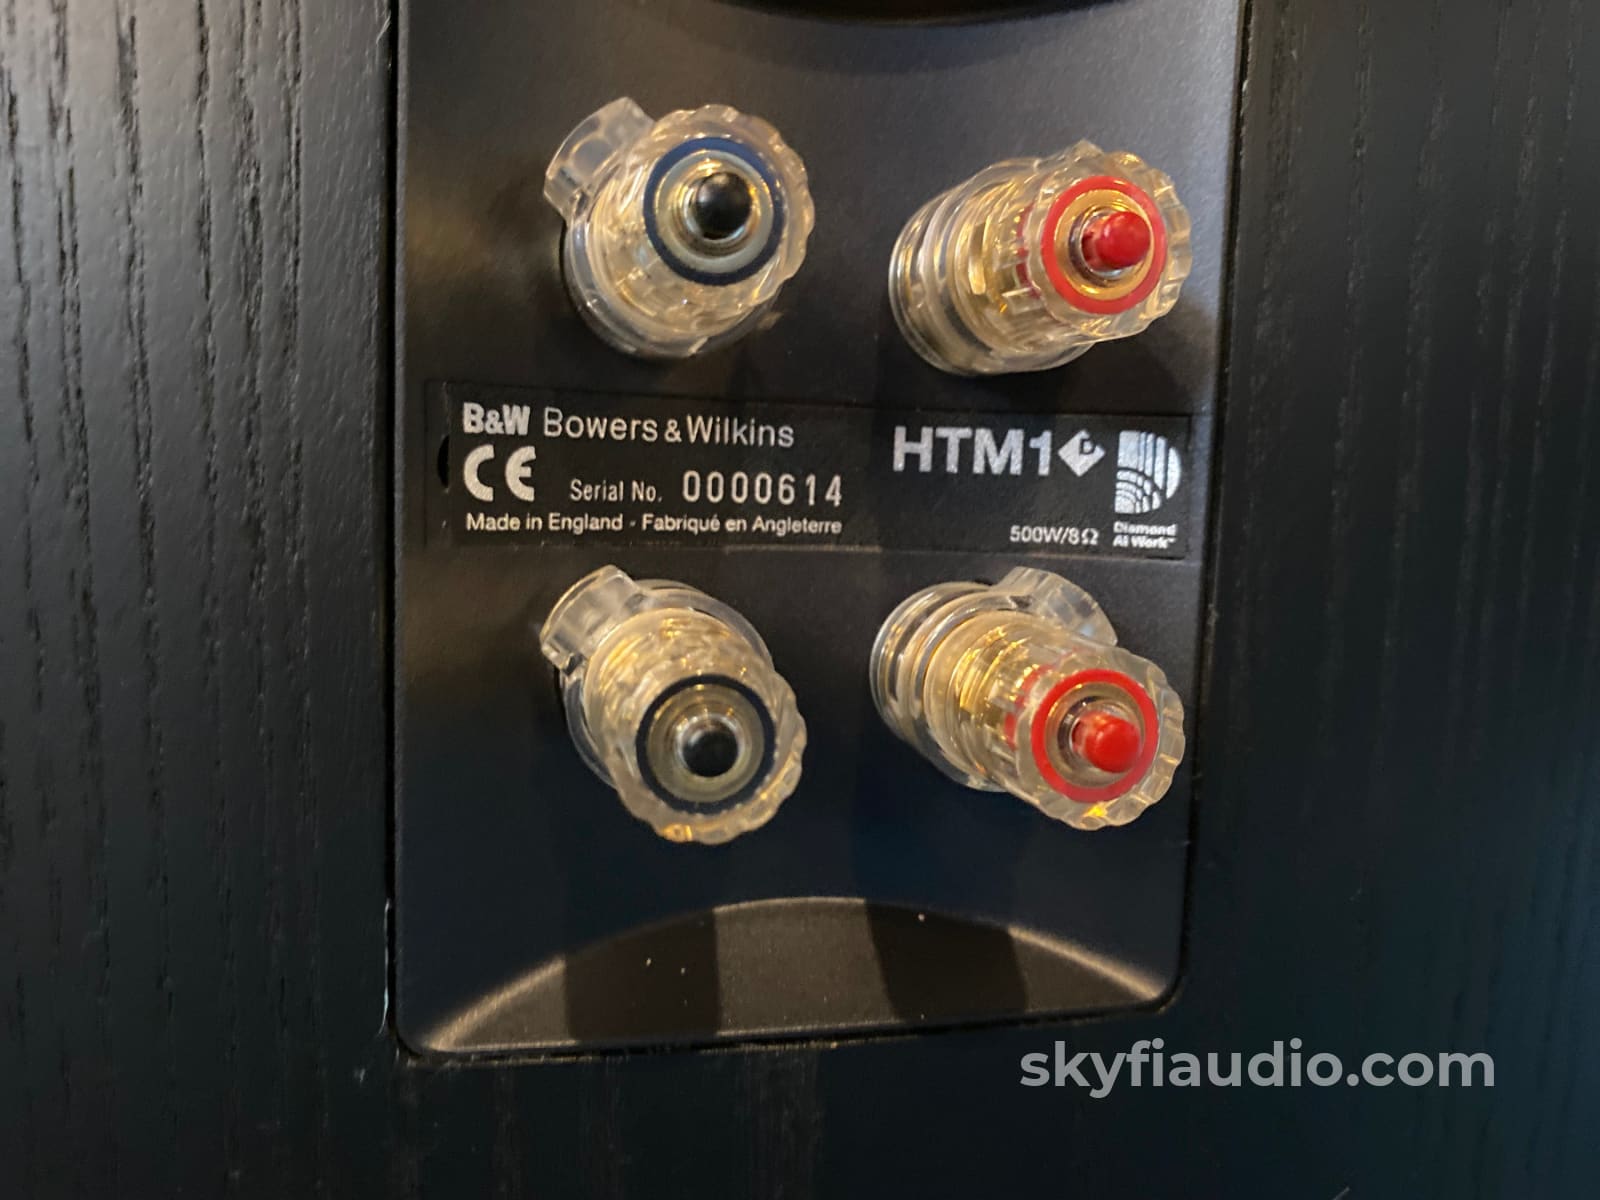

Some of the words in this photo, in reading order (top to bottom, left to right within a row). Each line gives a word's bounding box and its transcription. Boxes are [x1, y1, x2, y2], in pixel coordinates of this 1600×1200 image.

[463, 402, 530, 436] B&W
[544, 406, 658, 442] Bowers
[664, 419, 682, 442] &
[686, 414, 794, 447] Wilkins
[463, 444, 536, 502] CE
[569, 478, 624, 502] Serial
[682, 470, 842, 507] 0000614
[466, 512, 520, 531] Made
[526, 513, 543, 531] in
[549, 512, 623, 535] England
[642, 513, 720, 535] Fabriqué
[725, 519, 747, 533] en
[752, 515, 842, 537] Angleterre
